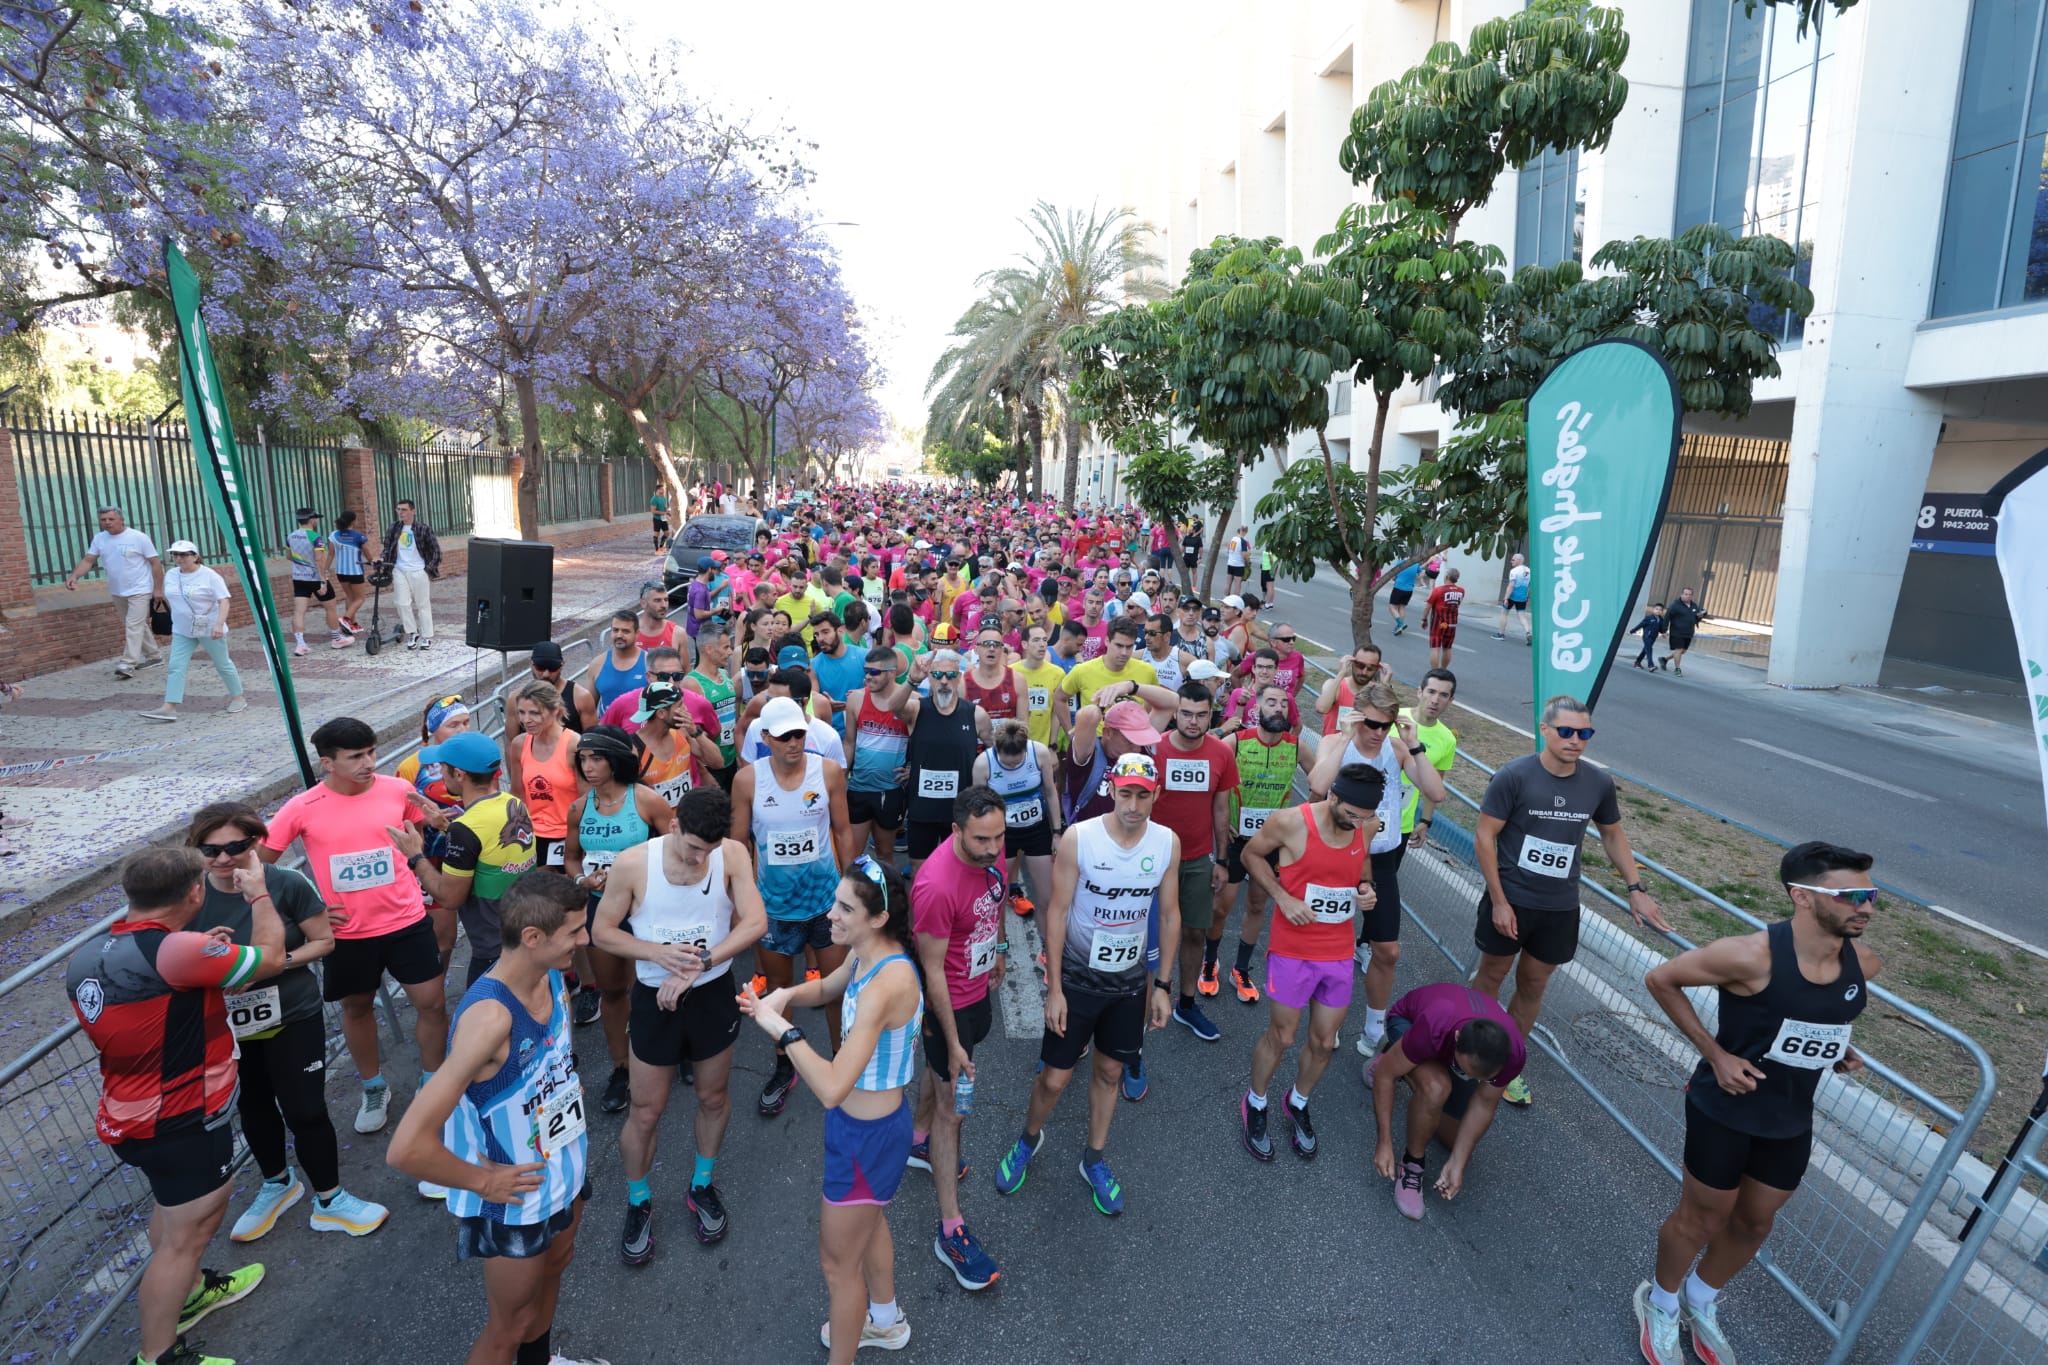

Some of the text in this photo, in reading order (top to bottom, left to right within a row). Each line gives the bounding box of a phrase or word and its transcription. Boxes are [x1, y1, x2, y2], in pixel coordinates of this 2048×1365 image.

[1943, 507, 1984, 519] PUERTA
[1942, 520, 1989, 531] 1942-2002
[1171, 770, 1205, 783] 690
[923, 779, 954, 791] 225
[1010, 806, 1039, 823] 108
[1528, 809, 1553, 817] URBAN
[774, 839, 815, 857] 334
[1527, 849, 1568, 869] 696
[338, 860, 389, 881] 430
[1093, 905, 1148, 921] PRIMOR
[1310, 898, 1352, 914] 294
[1097, 945, 1138, 962] 278
[1780, 1036, 1841, 1060] 668
[548, 1099, 583, 1139] 21
